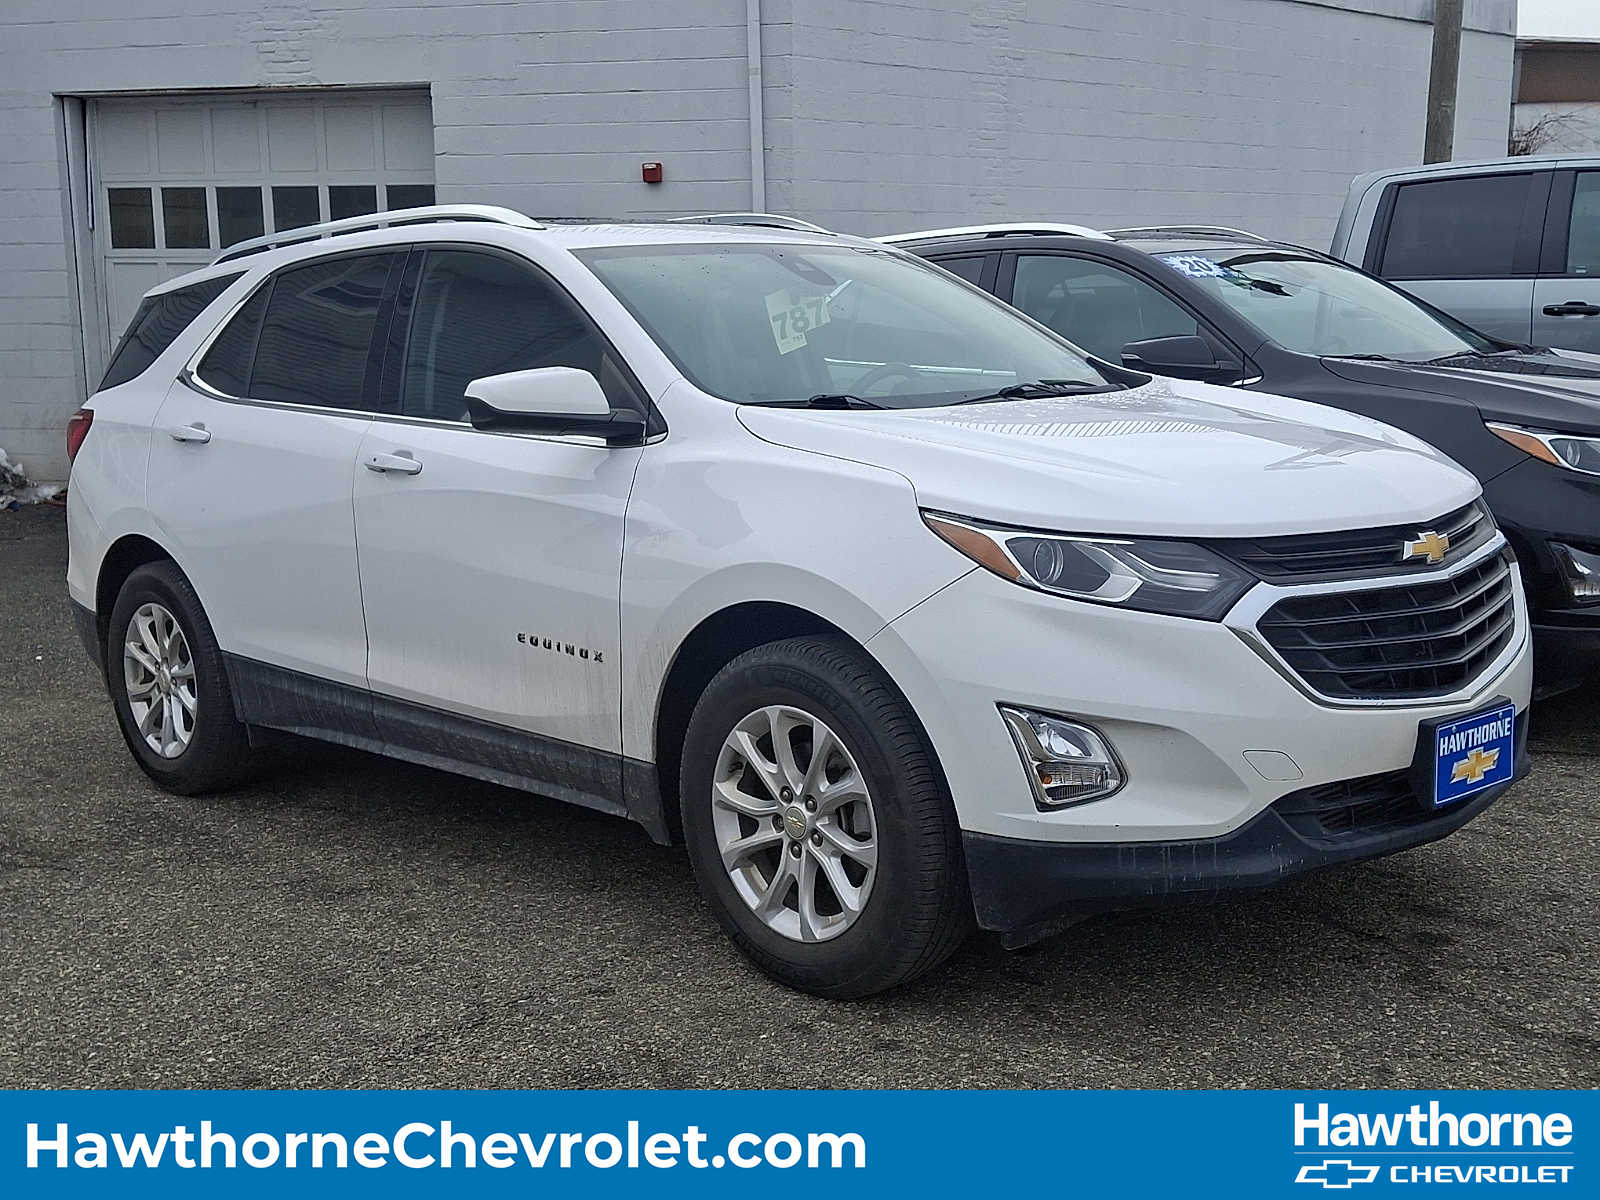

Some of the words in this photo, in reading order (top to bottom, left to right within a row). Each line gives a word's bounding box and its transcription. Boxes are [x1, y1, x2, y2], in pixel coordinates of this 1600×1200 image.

[1179, 258, 1214, 273] 20
[771, 300, 823, 341] 787
[516, 632, 604, 663] EQUINOX
[1439, 717, 1511, 757] HAWTHORNE
